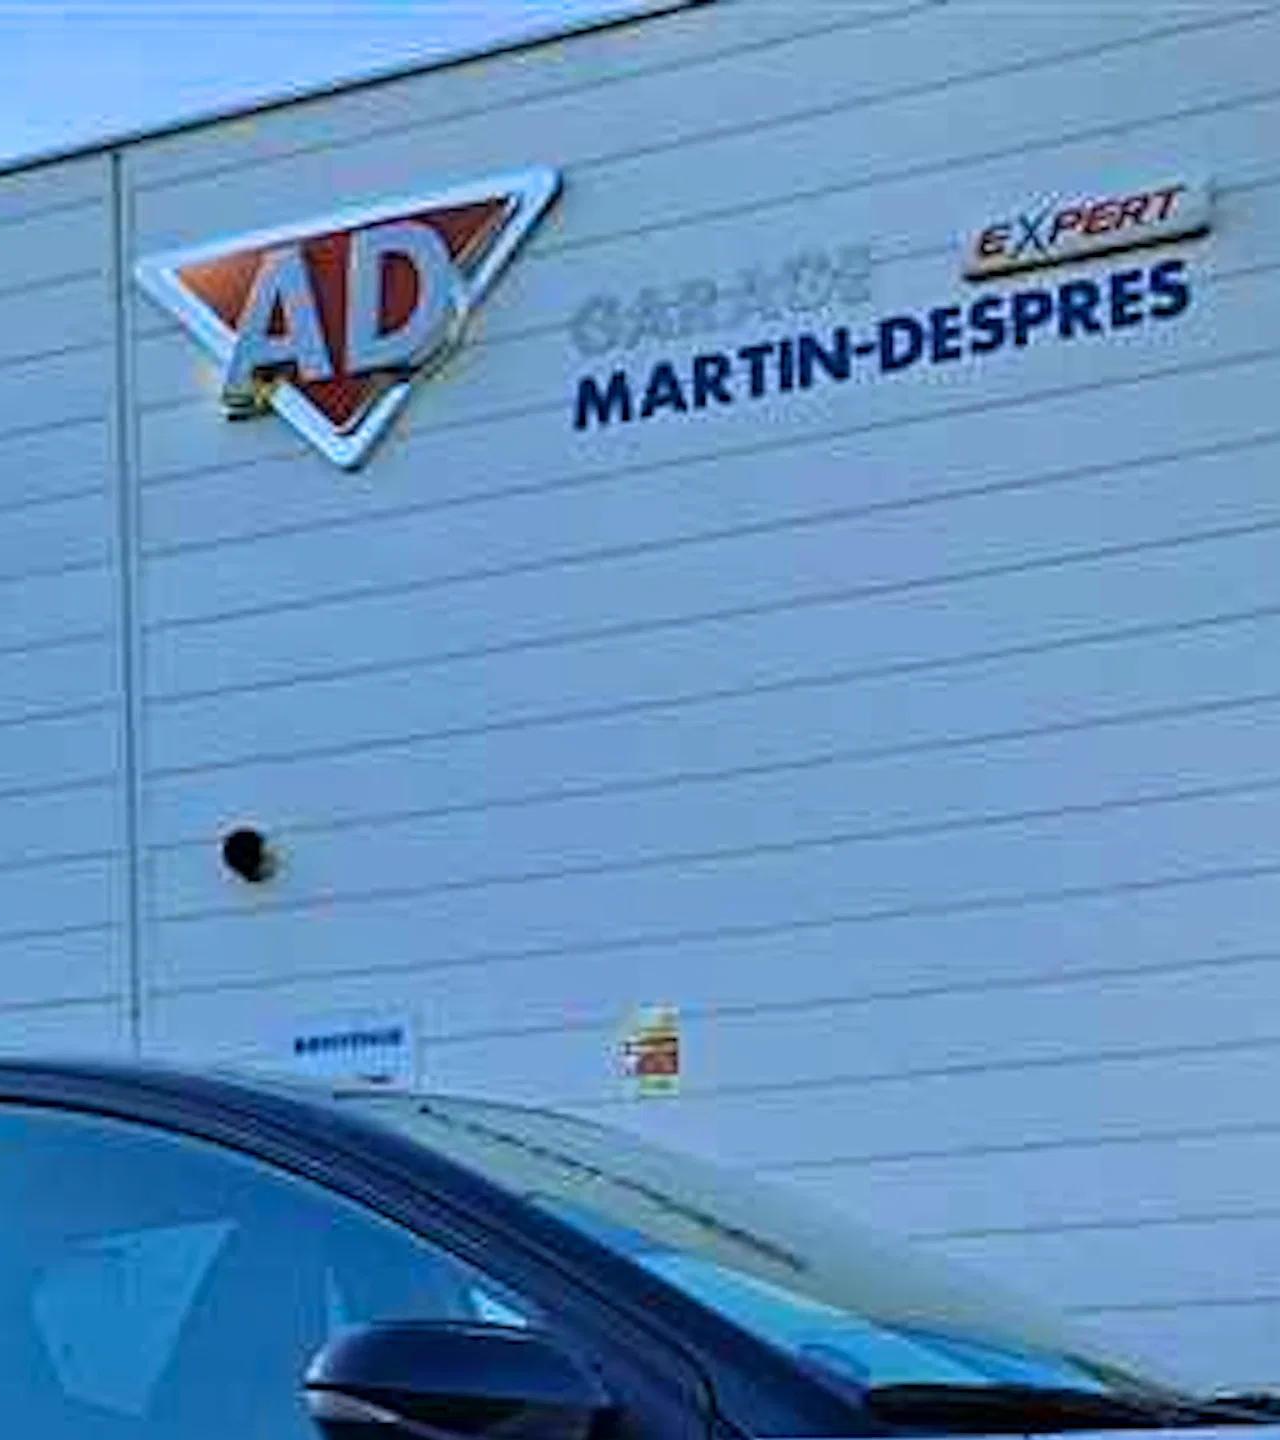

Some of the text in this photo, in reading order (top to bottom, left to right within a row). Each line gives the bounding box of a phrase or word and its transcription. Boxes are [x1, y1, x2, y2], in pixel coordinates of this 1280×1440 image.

[223, 222, 462, 390] AD
[976, 184, 1186, 260] EXPERT
[573, 260, 1191, 431] MARTIN-DESPRES
